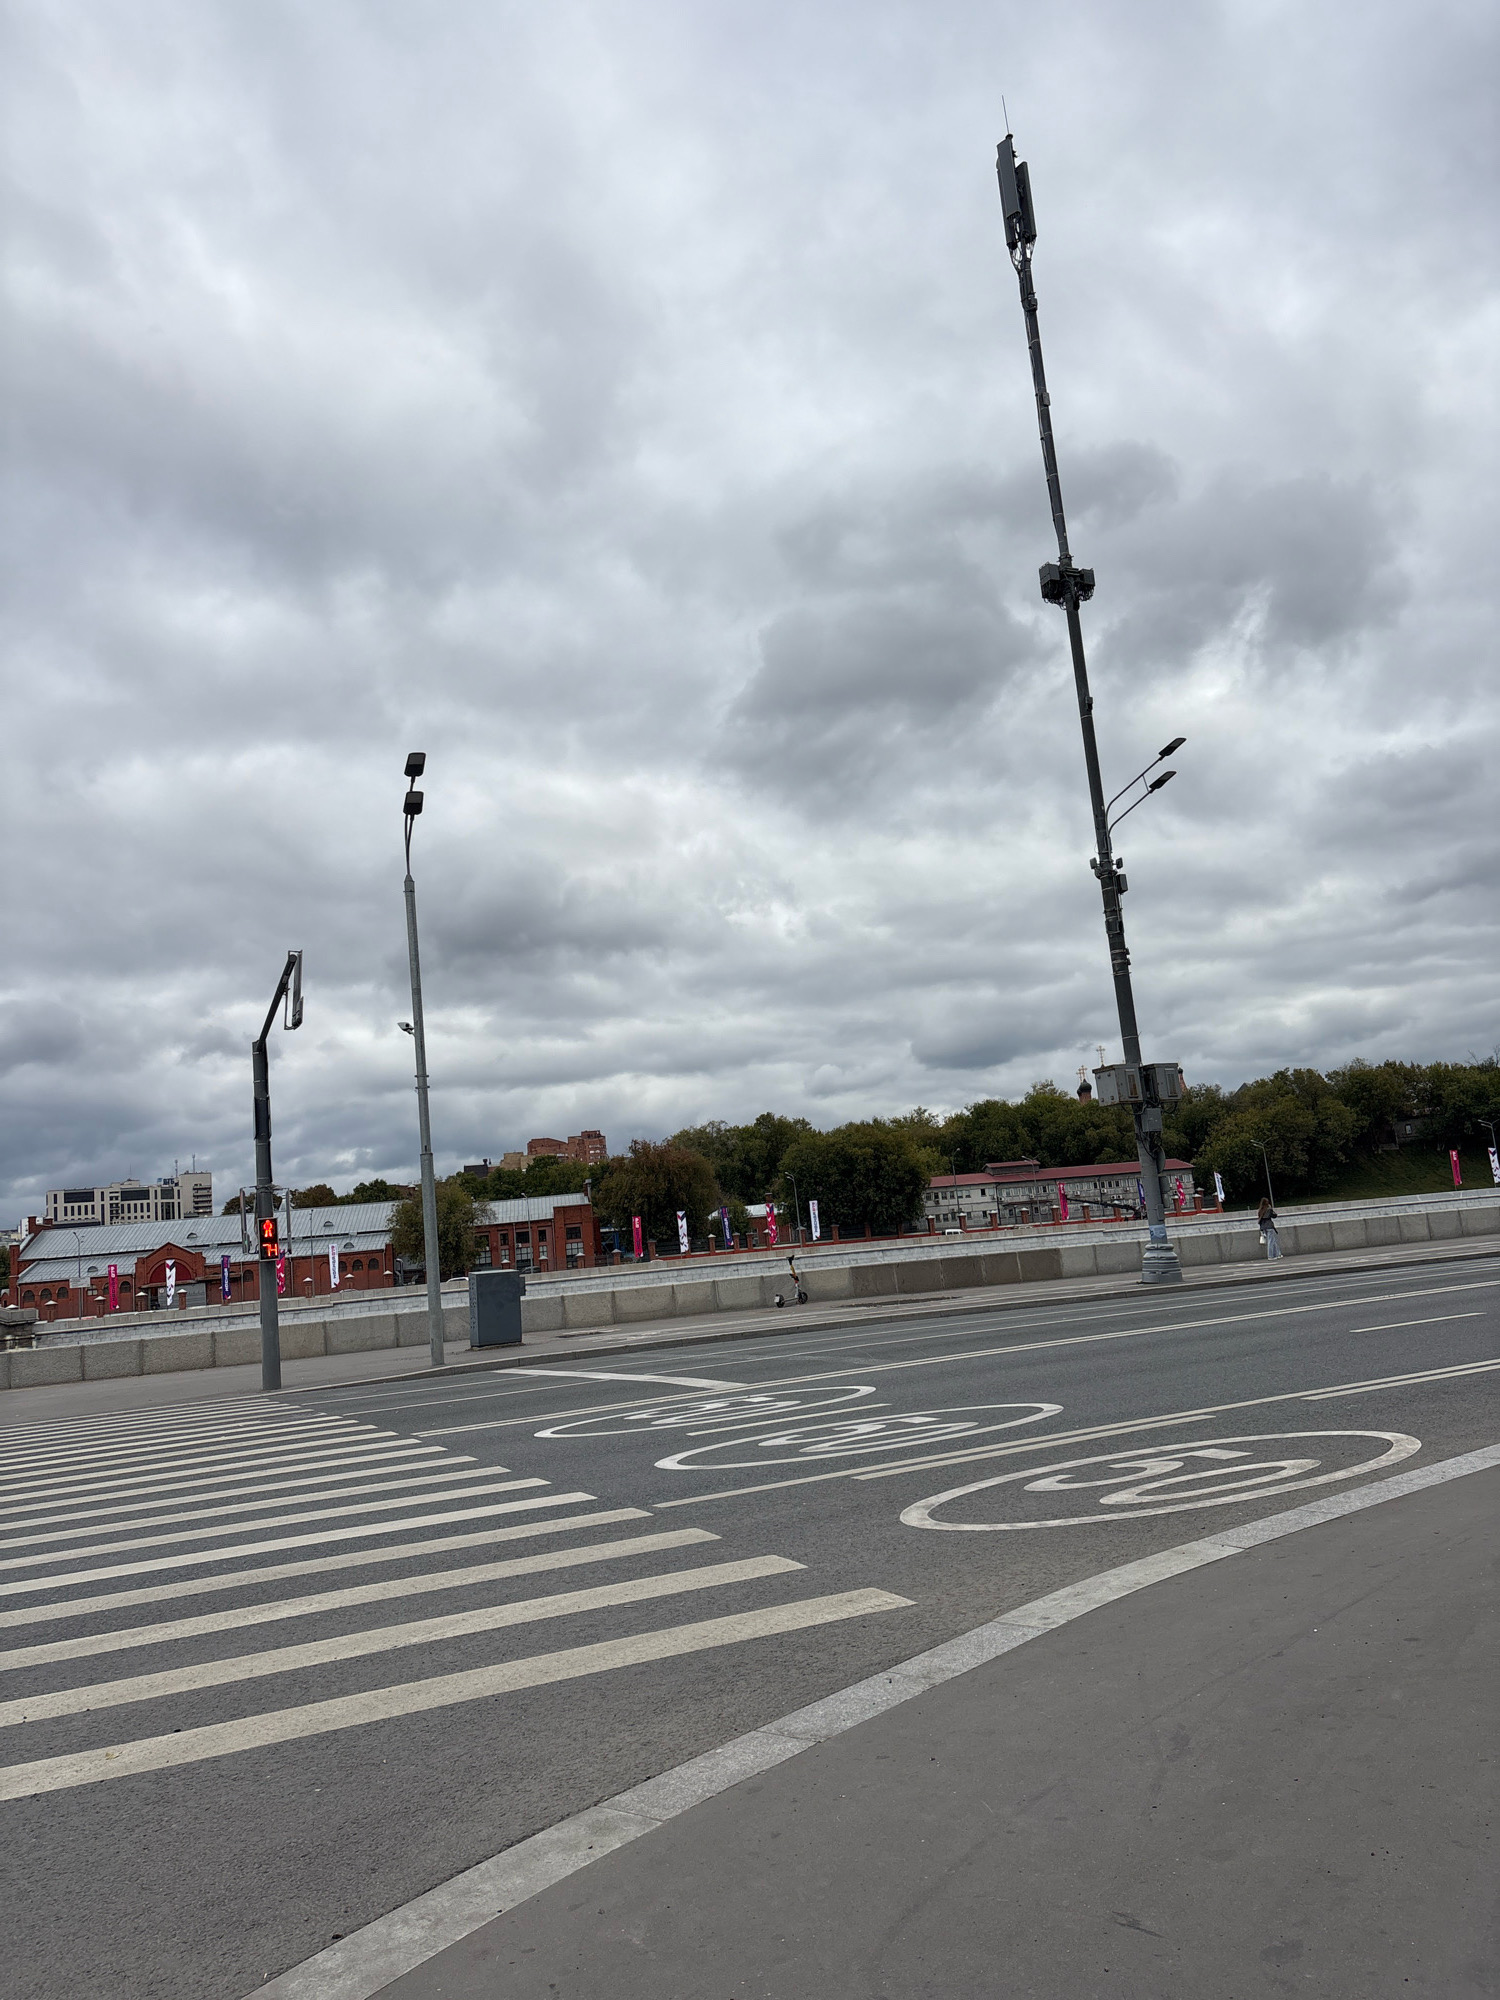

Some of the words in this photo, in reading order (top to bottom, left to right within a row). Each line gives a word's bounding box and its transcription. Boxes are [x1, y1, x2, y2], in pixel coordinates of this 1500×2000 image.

[624, 1396, 801, 1425] 50
[757, 1416, 979, 1453] 50
[1023, 1448, 1322, 1505] 50
